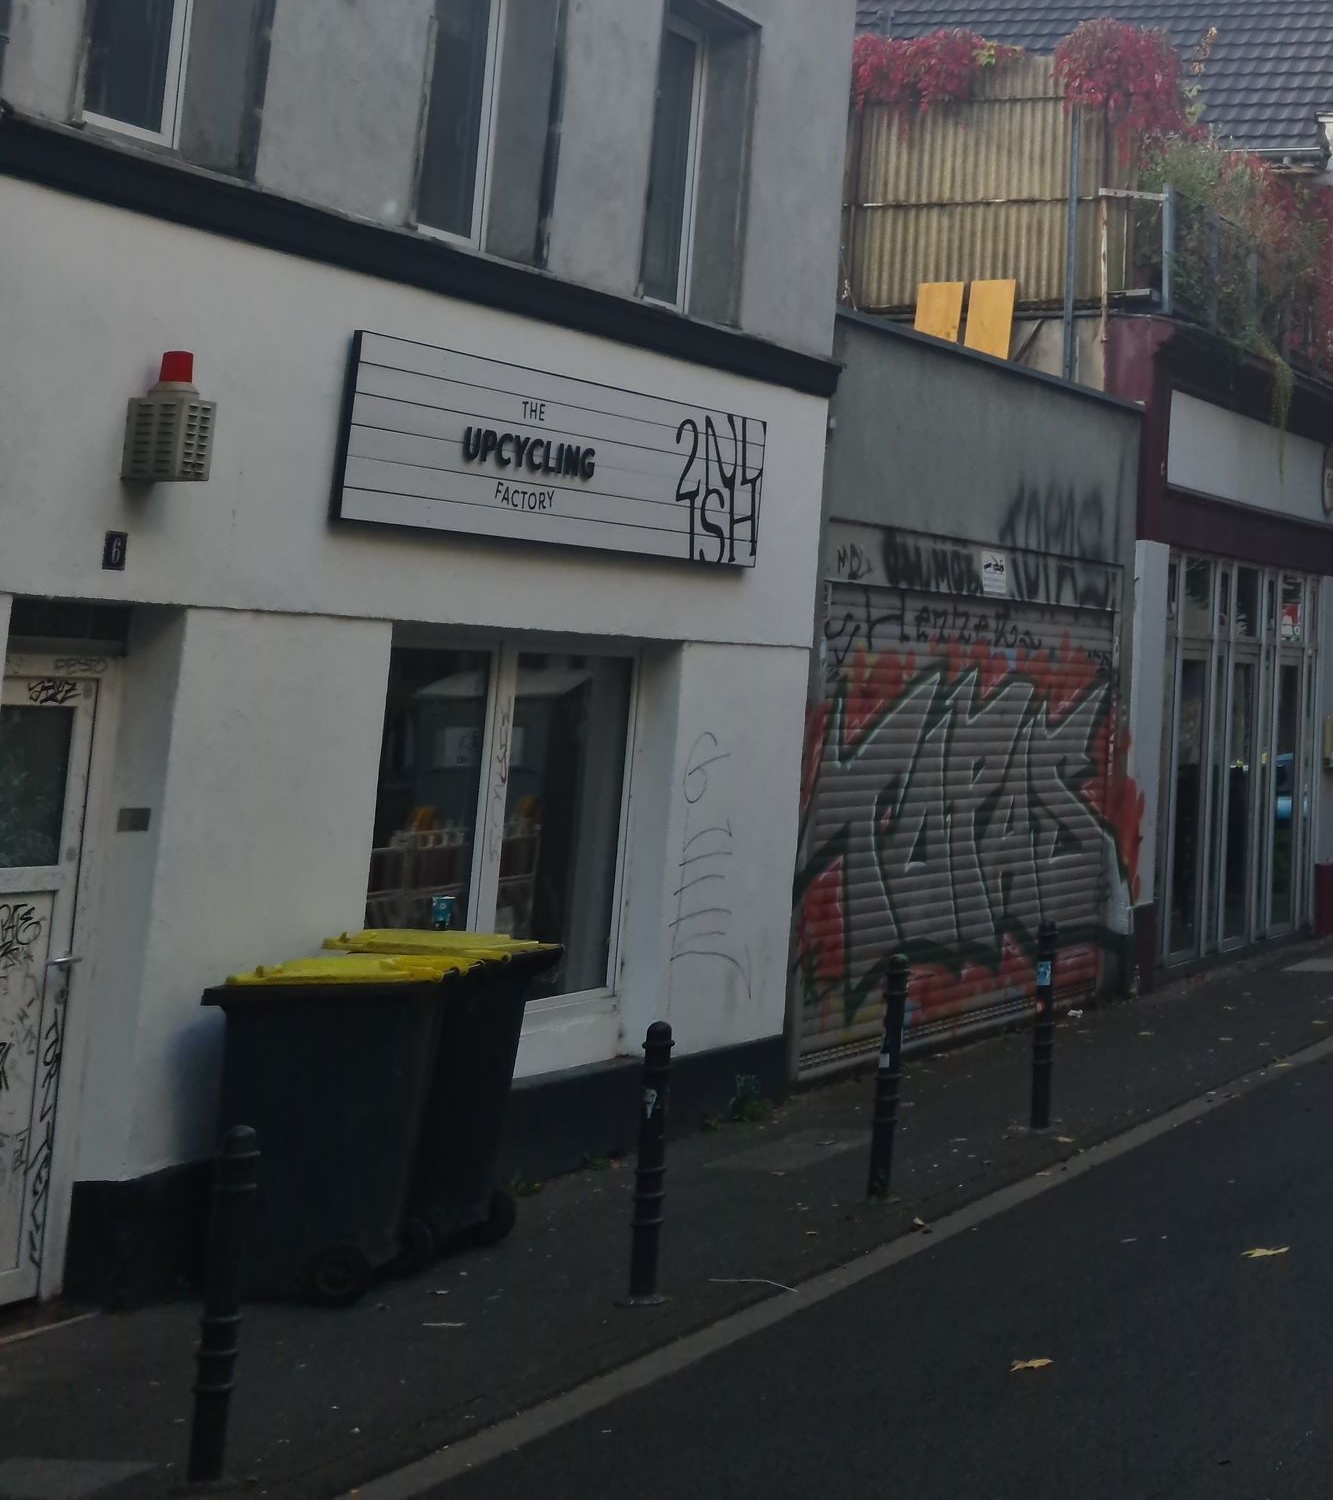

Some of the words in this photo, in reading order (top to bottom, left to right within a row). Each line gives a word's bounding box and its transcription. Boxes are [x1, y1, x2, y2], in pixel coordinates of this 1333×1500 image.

[522, 400, 546, 421] THE
[462, 426, 596, 480] UPCYCLING
[495, 481, 555, 510] FACTORY
[111, 537, 122, 564] 6
